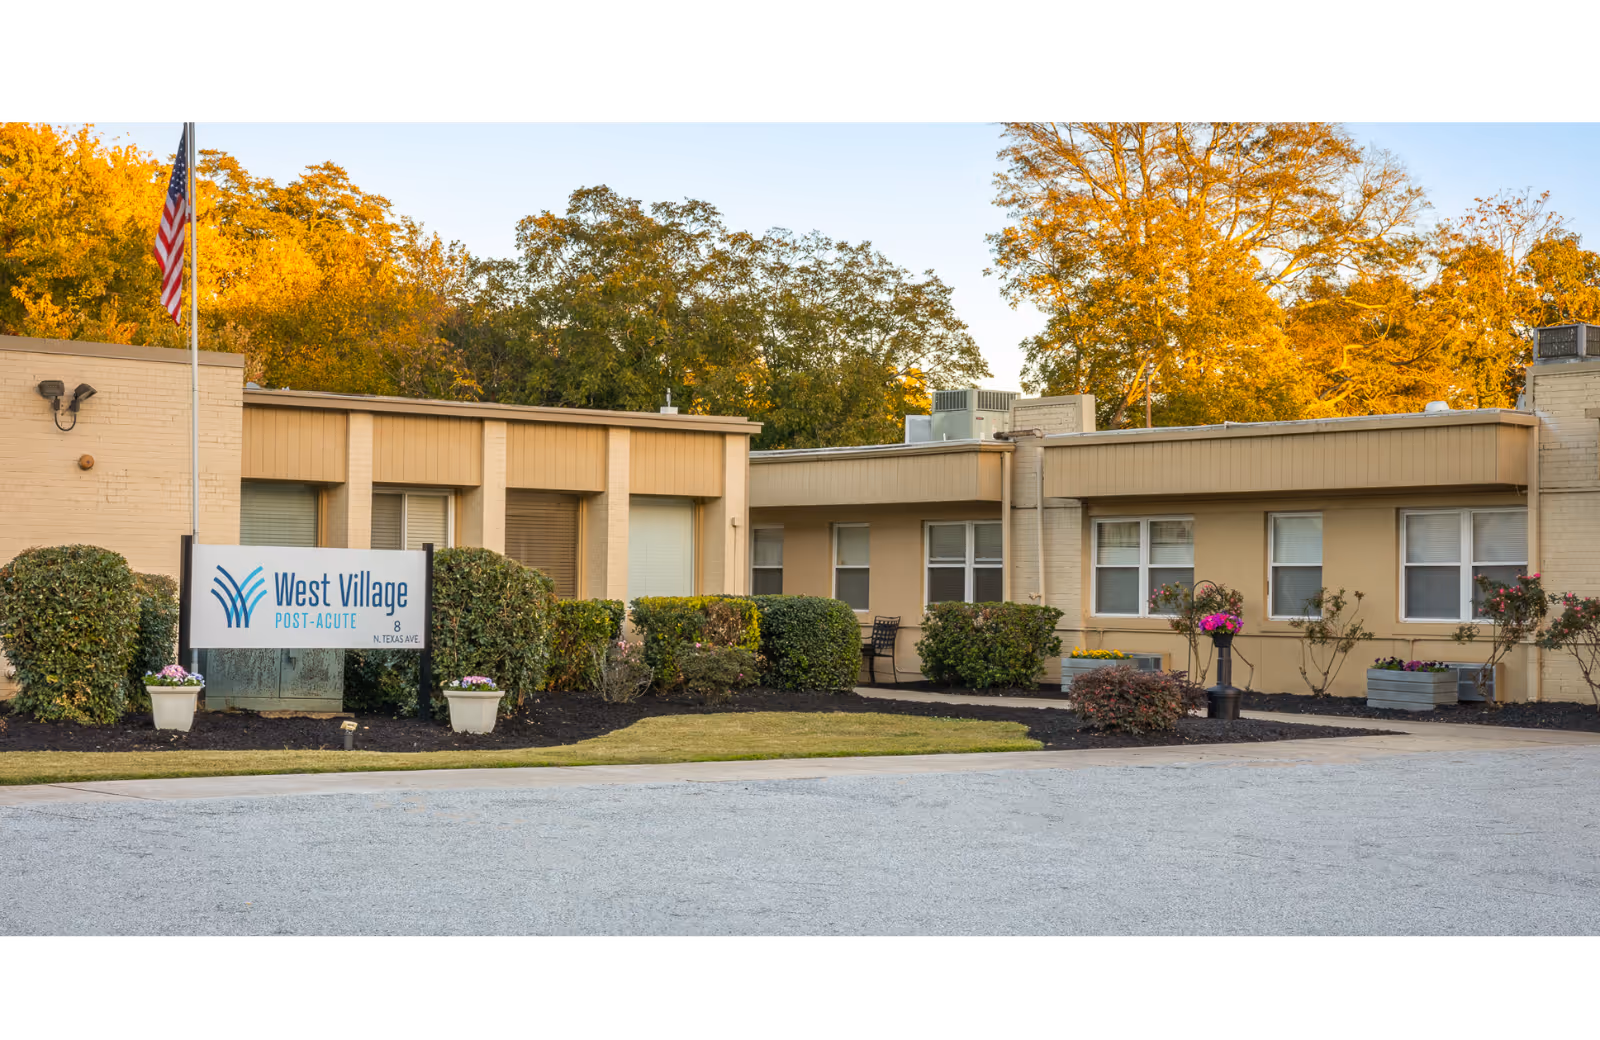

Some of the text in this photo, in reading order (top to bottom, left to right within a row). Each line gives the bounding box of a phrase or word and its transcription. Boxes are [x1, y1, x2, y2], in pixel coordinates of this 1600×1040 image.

[274, 570, 408, 616] West Village
[275, 612, 357, 629] POST-ACUTE
[393, 620, 401, 633] 8
[373, 634, 421, 644] N. TEXAS AVE.
